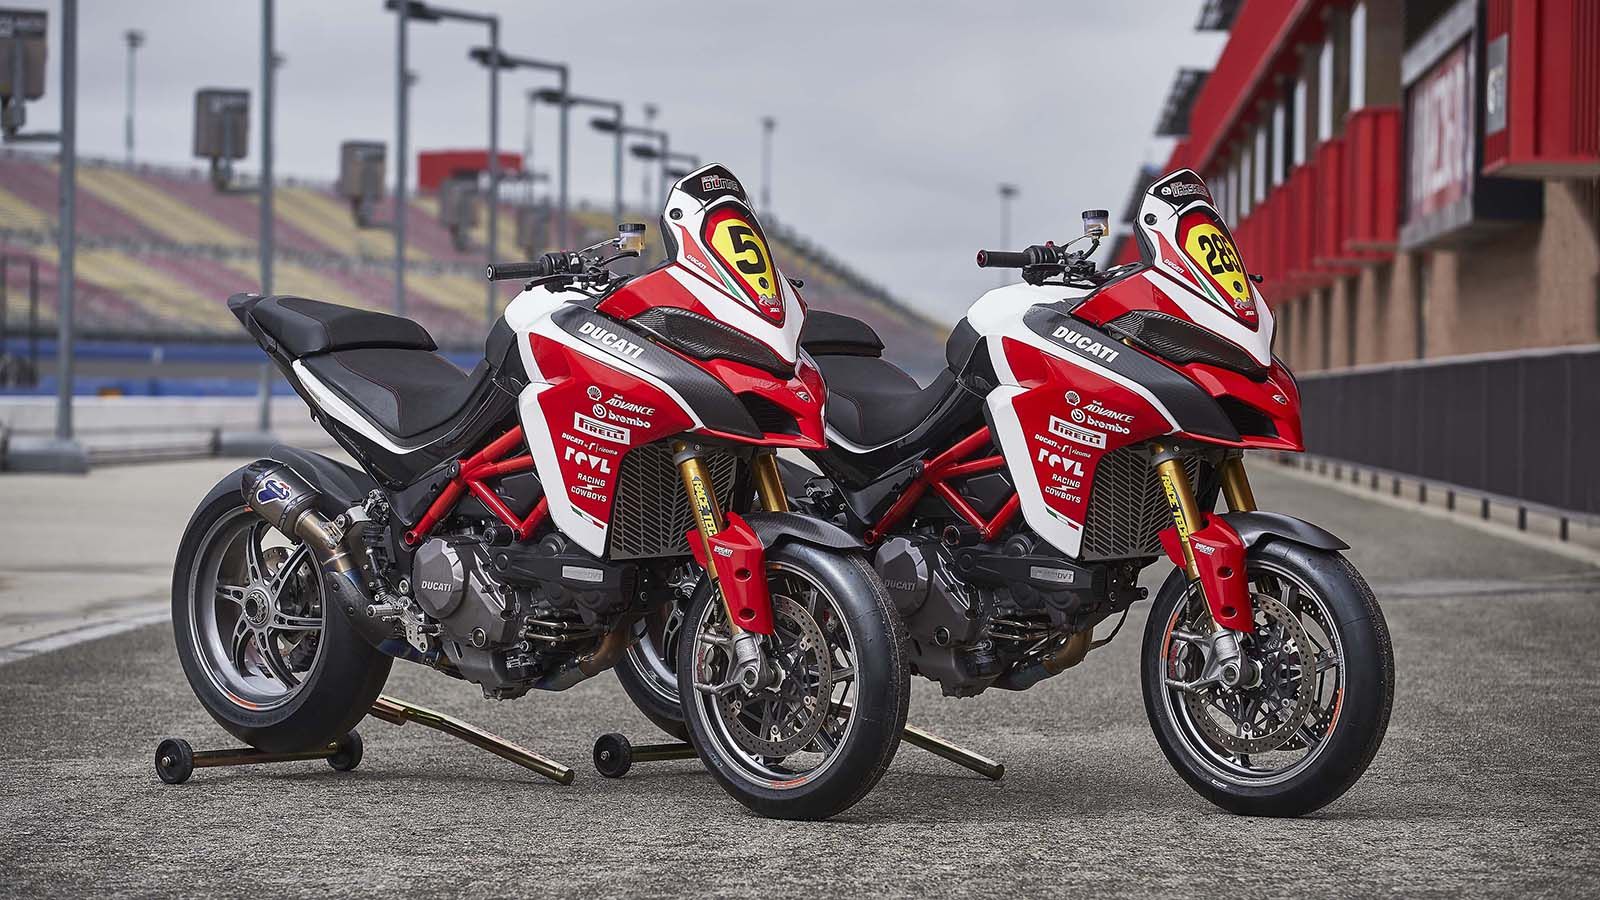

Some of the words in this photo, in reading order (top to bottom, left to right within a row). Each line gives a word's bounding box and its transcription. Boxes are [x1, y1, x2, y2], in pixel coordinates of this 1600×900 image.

[728, 225, 767, 274] 5
[1198, 233, 1242, 276] 285
[686, 254, 708, 270] DUCATI
[1163, 259, 1185, 274] DUCATI
[578, 321, 645, 360] DUCATI
[1052, 325, 1120, 364] DUCATI
[604, 397, 656, 416] ADVANCE
[1082, 403, 1136, 423] ADVANCE
[578, 417, 626, 441] PIRELLI
[608, 409, 652, 429] brembo
[1087, 414, 1131, 435] brembo
[561, 432, 585, 446] DUCATI
[1053, 420, 1102, 445] PIRELLI
[1034, 433, 1057, 447] DUCATI
[1071, 449, 1092, 459] rizoma
[577, 472, 606, 487] RACING
[1052, 473, 1081, 488] RACING
[571, 486, 607, 502] COWBOYS
[692, 479, 711, 515] RACE
[1045, 486, 1081, 504] COWBOYS
[1161, 474, 1180, 509] RACE
[1173, 507, 1190, 542] TECH
[421, 580, 452, 593] DUCATI
[884, 579, 917, 592] DUCATI
